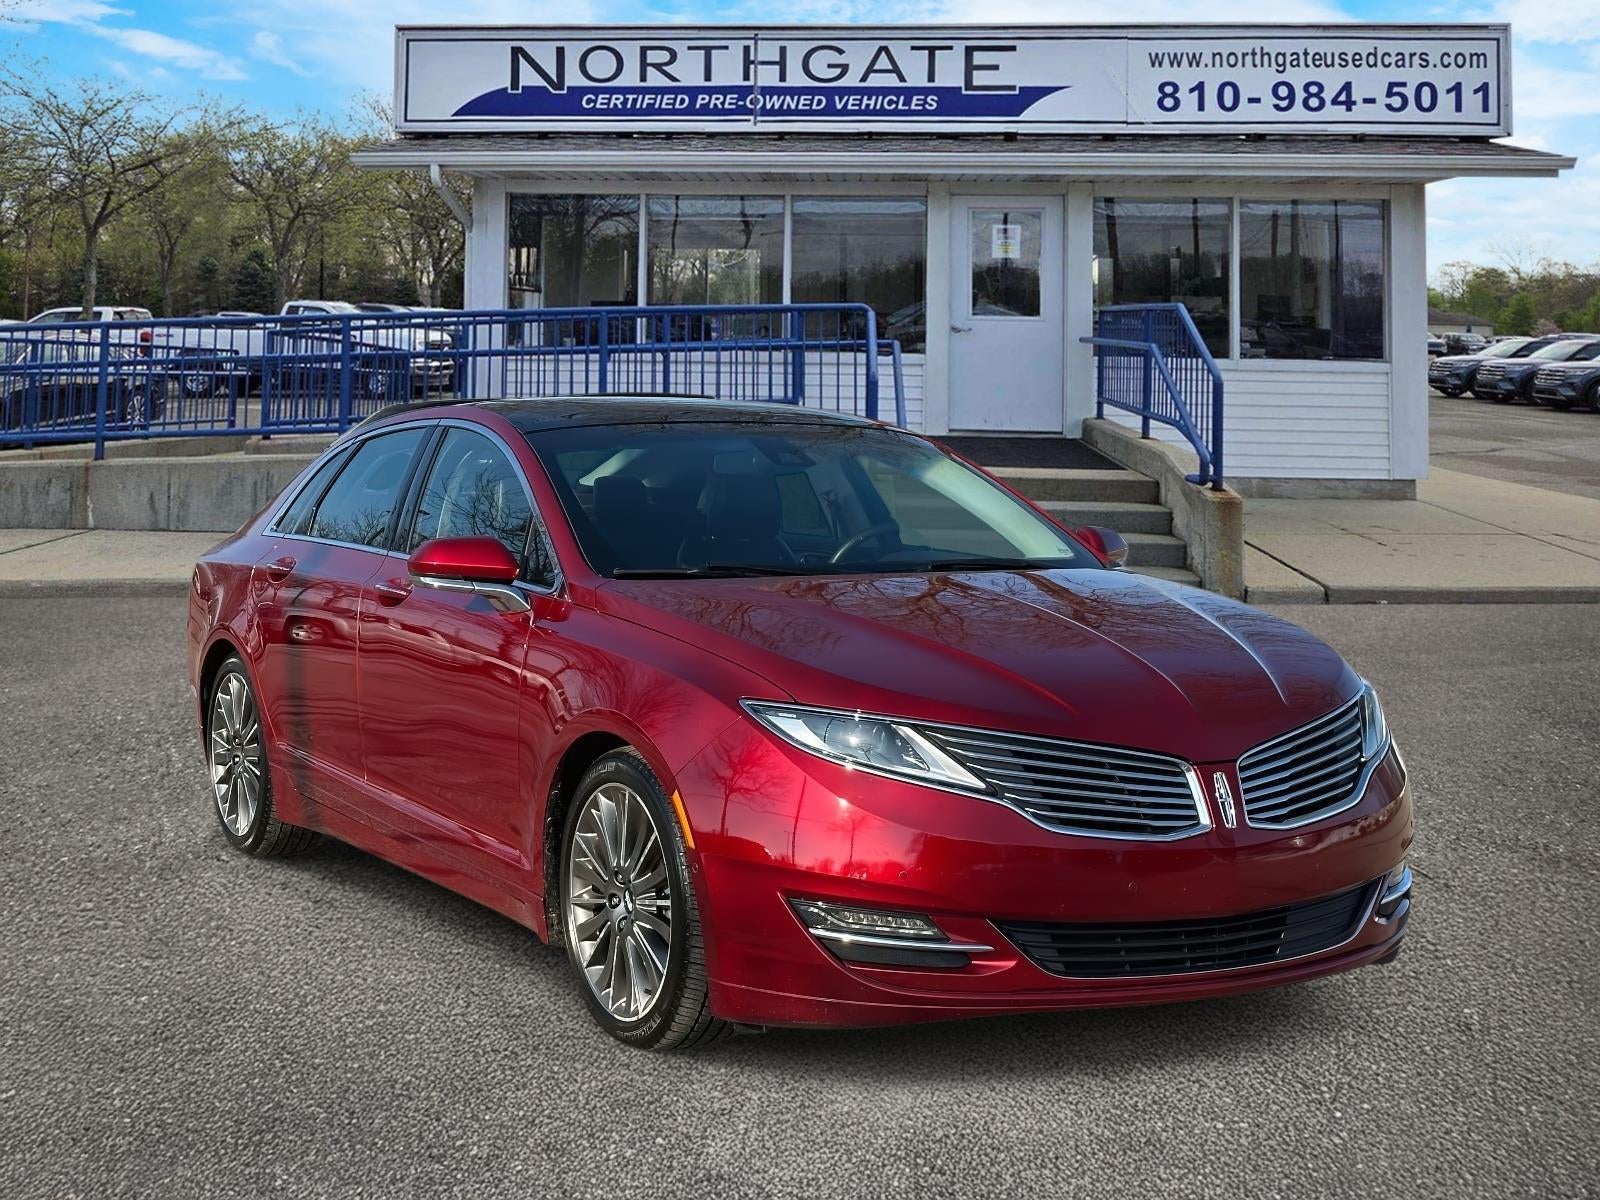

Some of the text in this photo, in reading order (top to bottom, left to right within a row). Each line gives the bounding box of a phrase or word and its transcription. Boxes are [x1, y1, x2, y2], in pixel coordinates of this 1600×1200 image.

[510, 45, 1018, 93] NORTHGATE
[1148, 47, 1488, 74] www.northgateusedcars.com
[581, 93, 939, 110] CERTIFIED PRE-OWNED VEHICLES
[1156, 80, 1491, 113] 810-984-5011
